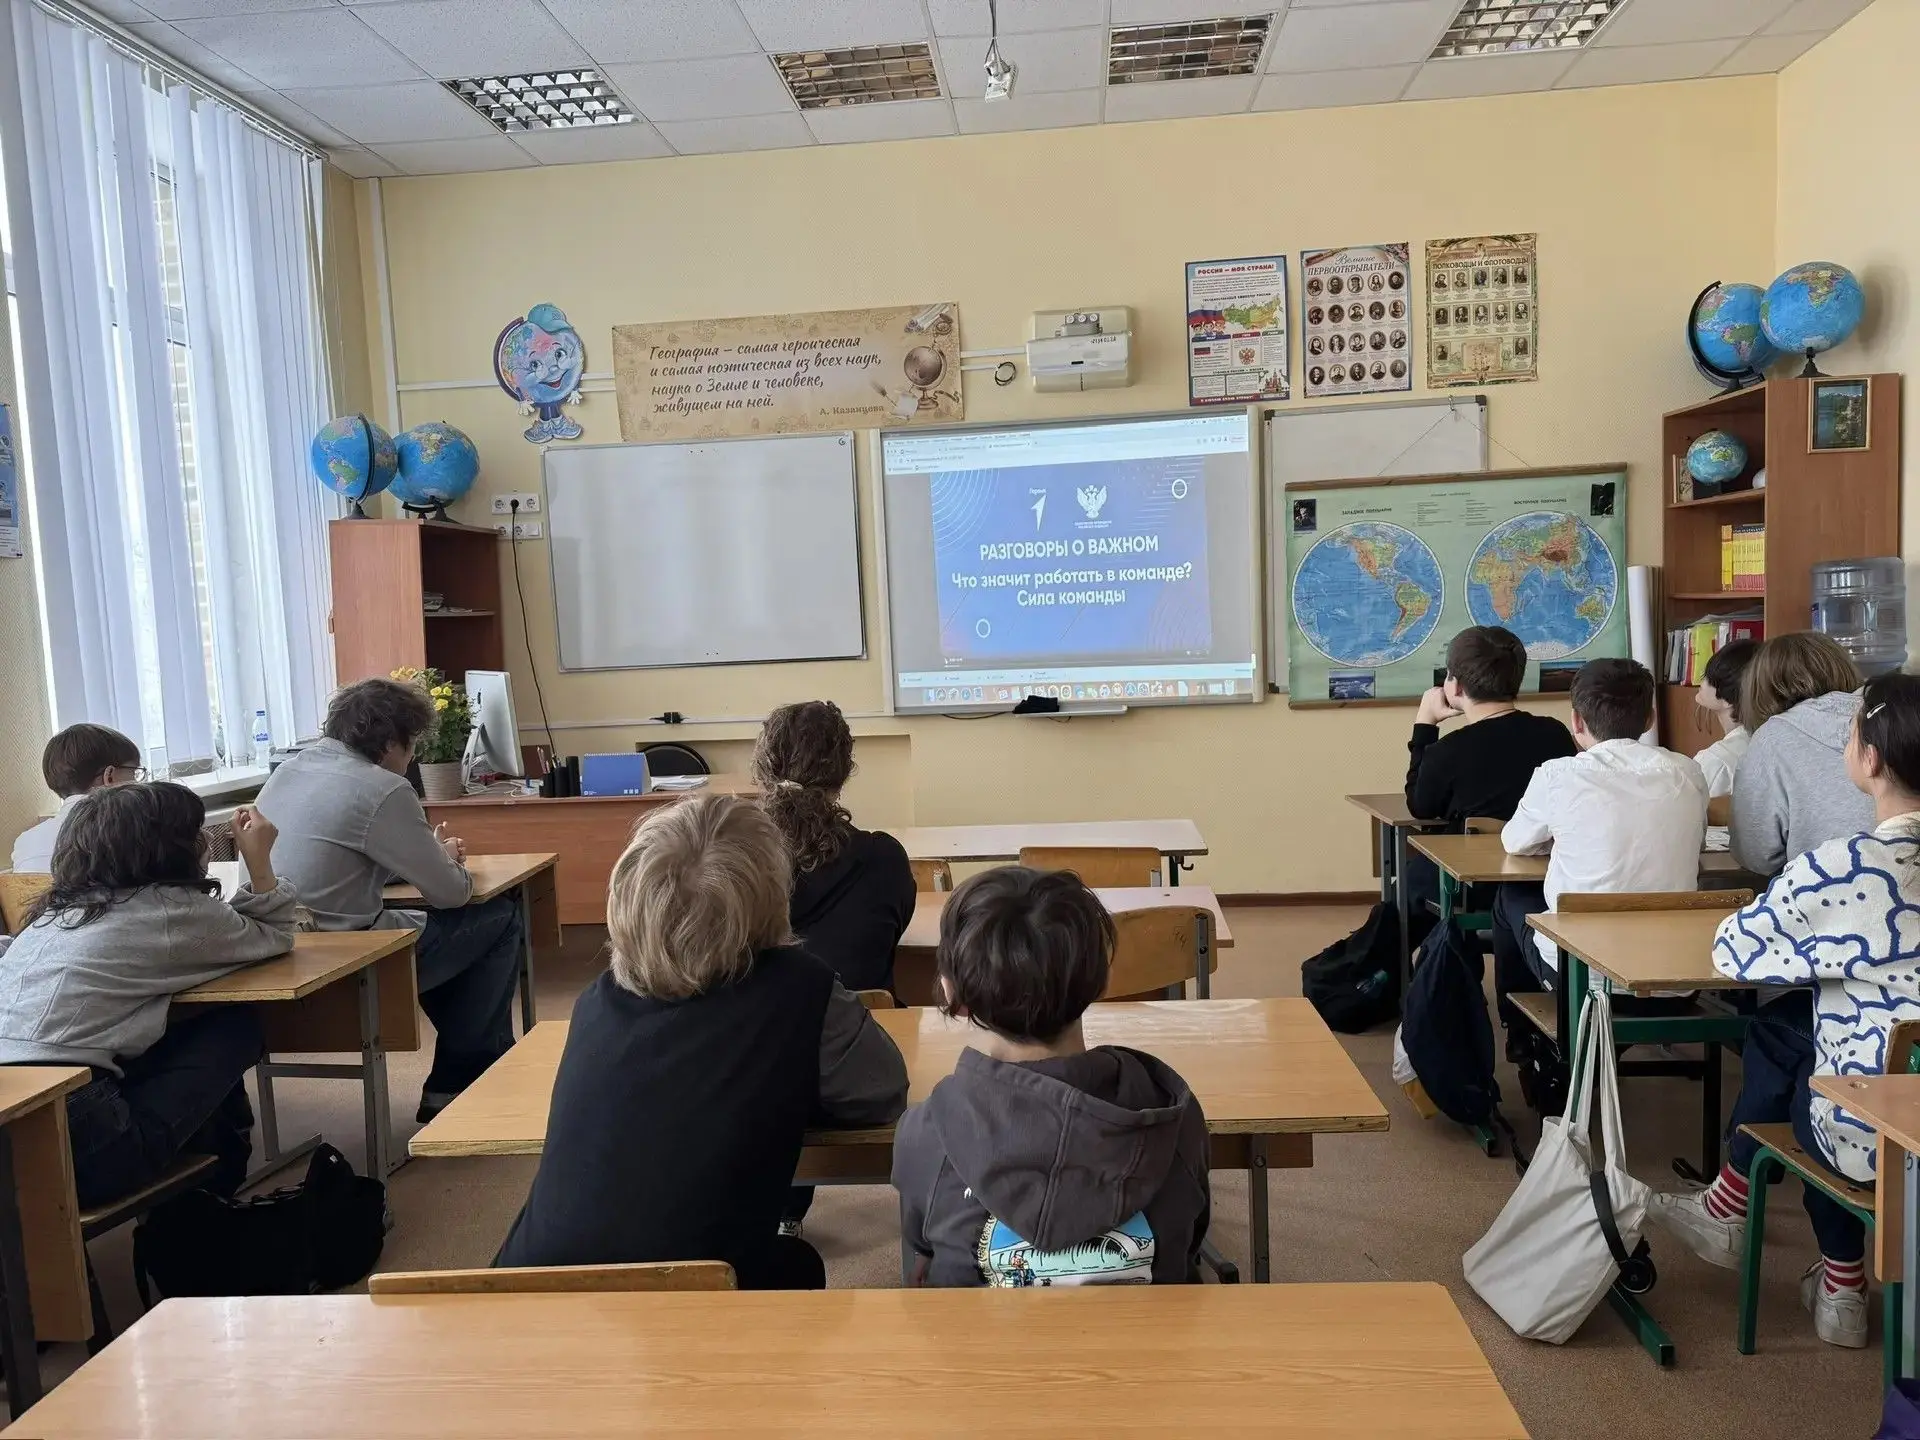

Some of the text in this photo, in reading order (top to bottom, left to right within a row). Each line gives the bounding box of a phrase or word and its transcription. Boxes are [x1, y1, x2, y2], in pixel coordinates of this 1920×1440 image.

[1197, 267, 1223, 275] РОССИЯ
[1308, 261, 1395, 275] ПЕРВООТКРЫВАТЕЛИ
[1433, 260, 1477, 269] ПОЛКОВОДЦЫ
[1484, 258, 1529, 266] ФЛОТОВОДЦЫ
[650, 346, 719, 362] География
[737, 343, 778, 355] самая
[782, 337, 861, 355] героическая
[650, 352, 881, 376] и самая поэтическая из всех наук,
[651, 371, 824, 400] наука о Земле и человеке,
[653, 394, 774, 417] живущем на ней.
[820, 408, 829, 416] А.
[980, 535, 1159, 561] РАЗГОВОРЫ О ВАЖНОМ
[951, 561, 1192, 589] Что значит работать в команде?
[1017, 589, 1126, 607] Сила команды
